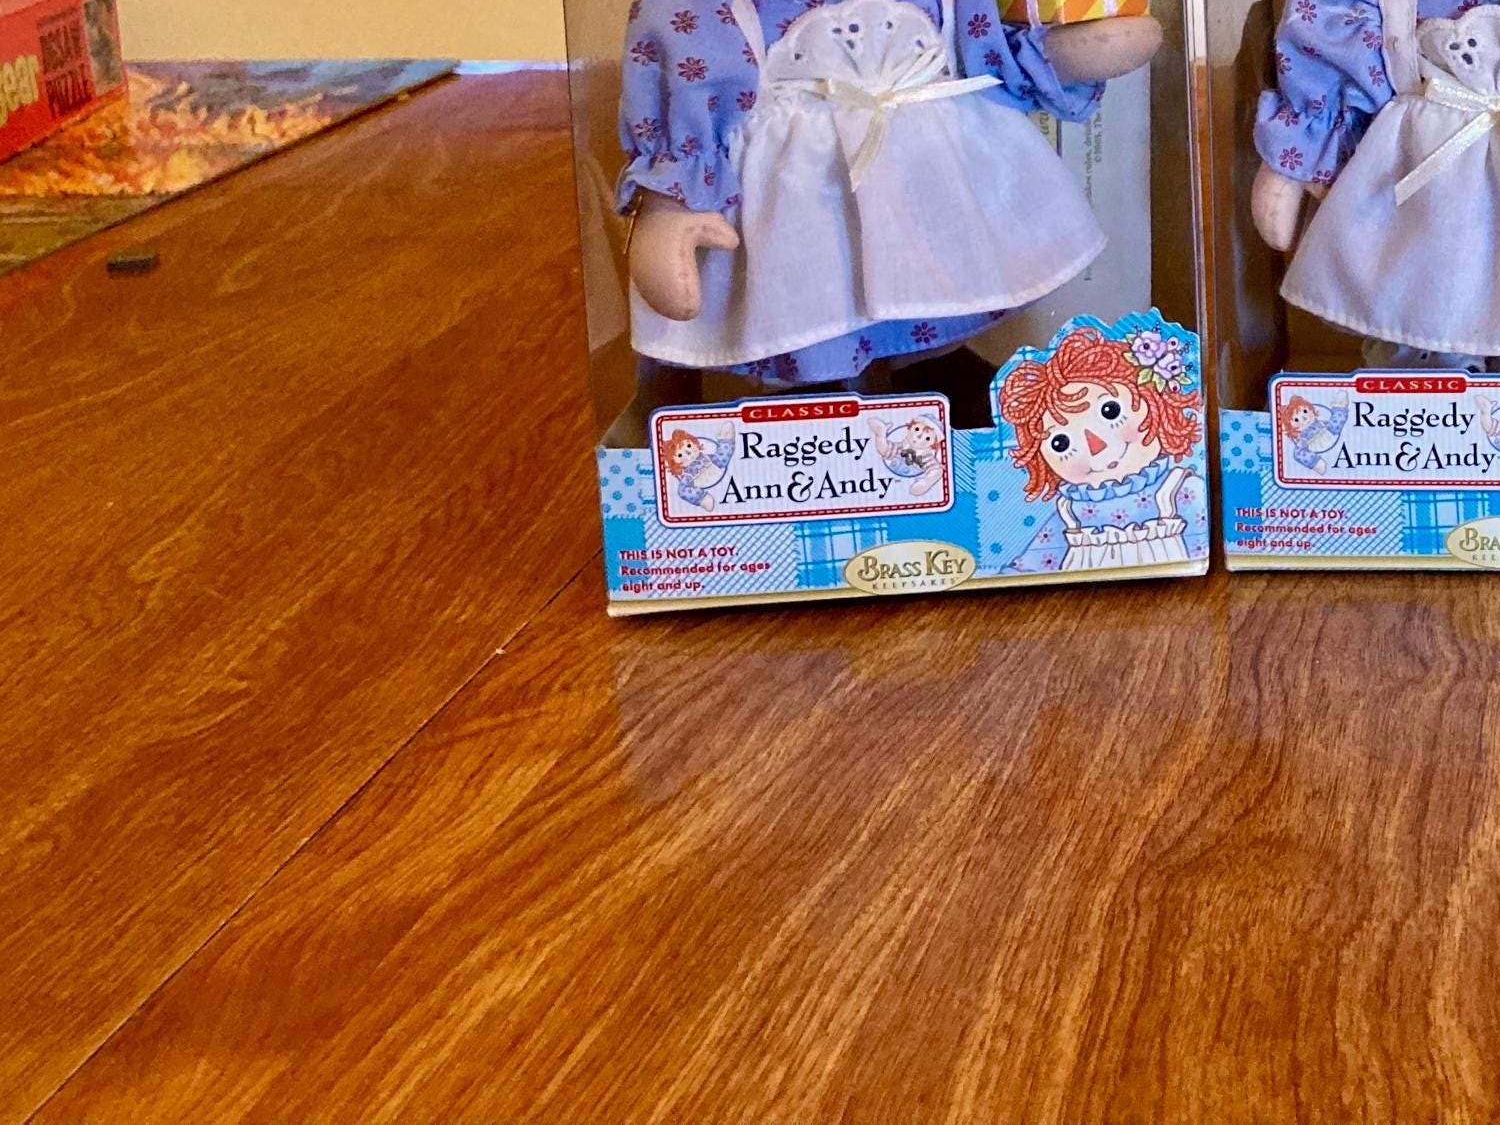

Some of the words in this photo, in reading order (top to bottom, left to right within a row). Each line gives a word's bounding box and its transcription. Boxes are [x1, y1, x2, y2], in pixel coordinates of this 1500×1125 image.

[1363, 380, 1460, 390] CLASSIC
[750, 404, 851, 419] CLASSIC
[1353, 401, 1475, 437] Raggedy
[740, 426, 870, 467] Raggedy
[1236, 508, 1262, 518] THIS
[1265, 508, 1276, 518] IS
[1280, 508, 1306, 519] NOT
[1309, 509, 1319, 519] A
[1236, 522, 1324, 534] Recommended
[1327, 524, 1345, 534] for
[1348, 526, 1377, 536] ages
[1236, 537, 1267, 549] eight
[1270, 538, 1293, 548] and
[620, 550, 647, 560] THIS
[651, 549, 662, 559] IS
[667, 548, 694, 559] NOT
[697, 548, 708, 558] A
[620, 562, 714, 576] Recommended
[717, 561, 736, 573] for
[739, 561, 771, 574] ages
[857, 555, 921, 582] BRASS
[924, 549, 967, 576] KEY
[622, 580, 653, 593] eight
[657, 579, 681, 591] and
